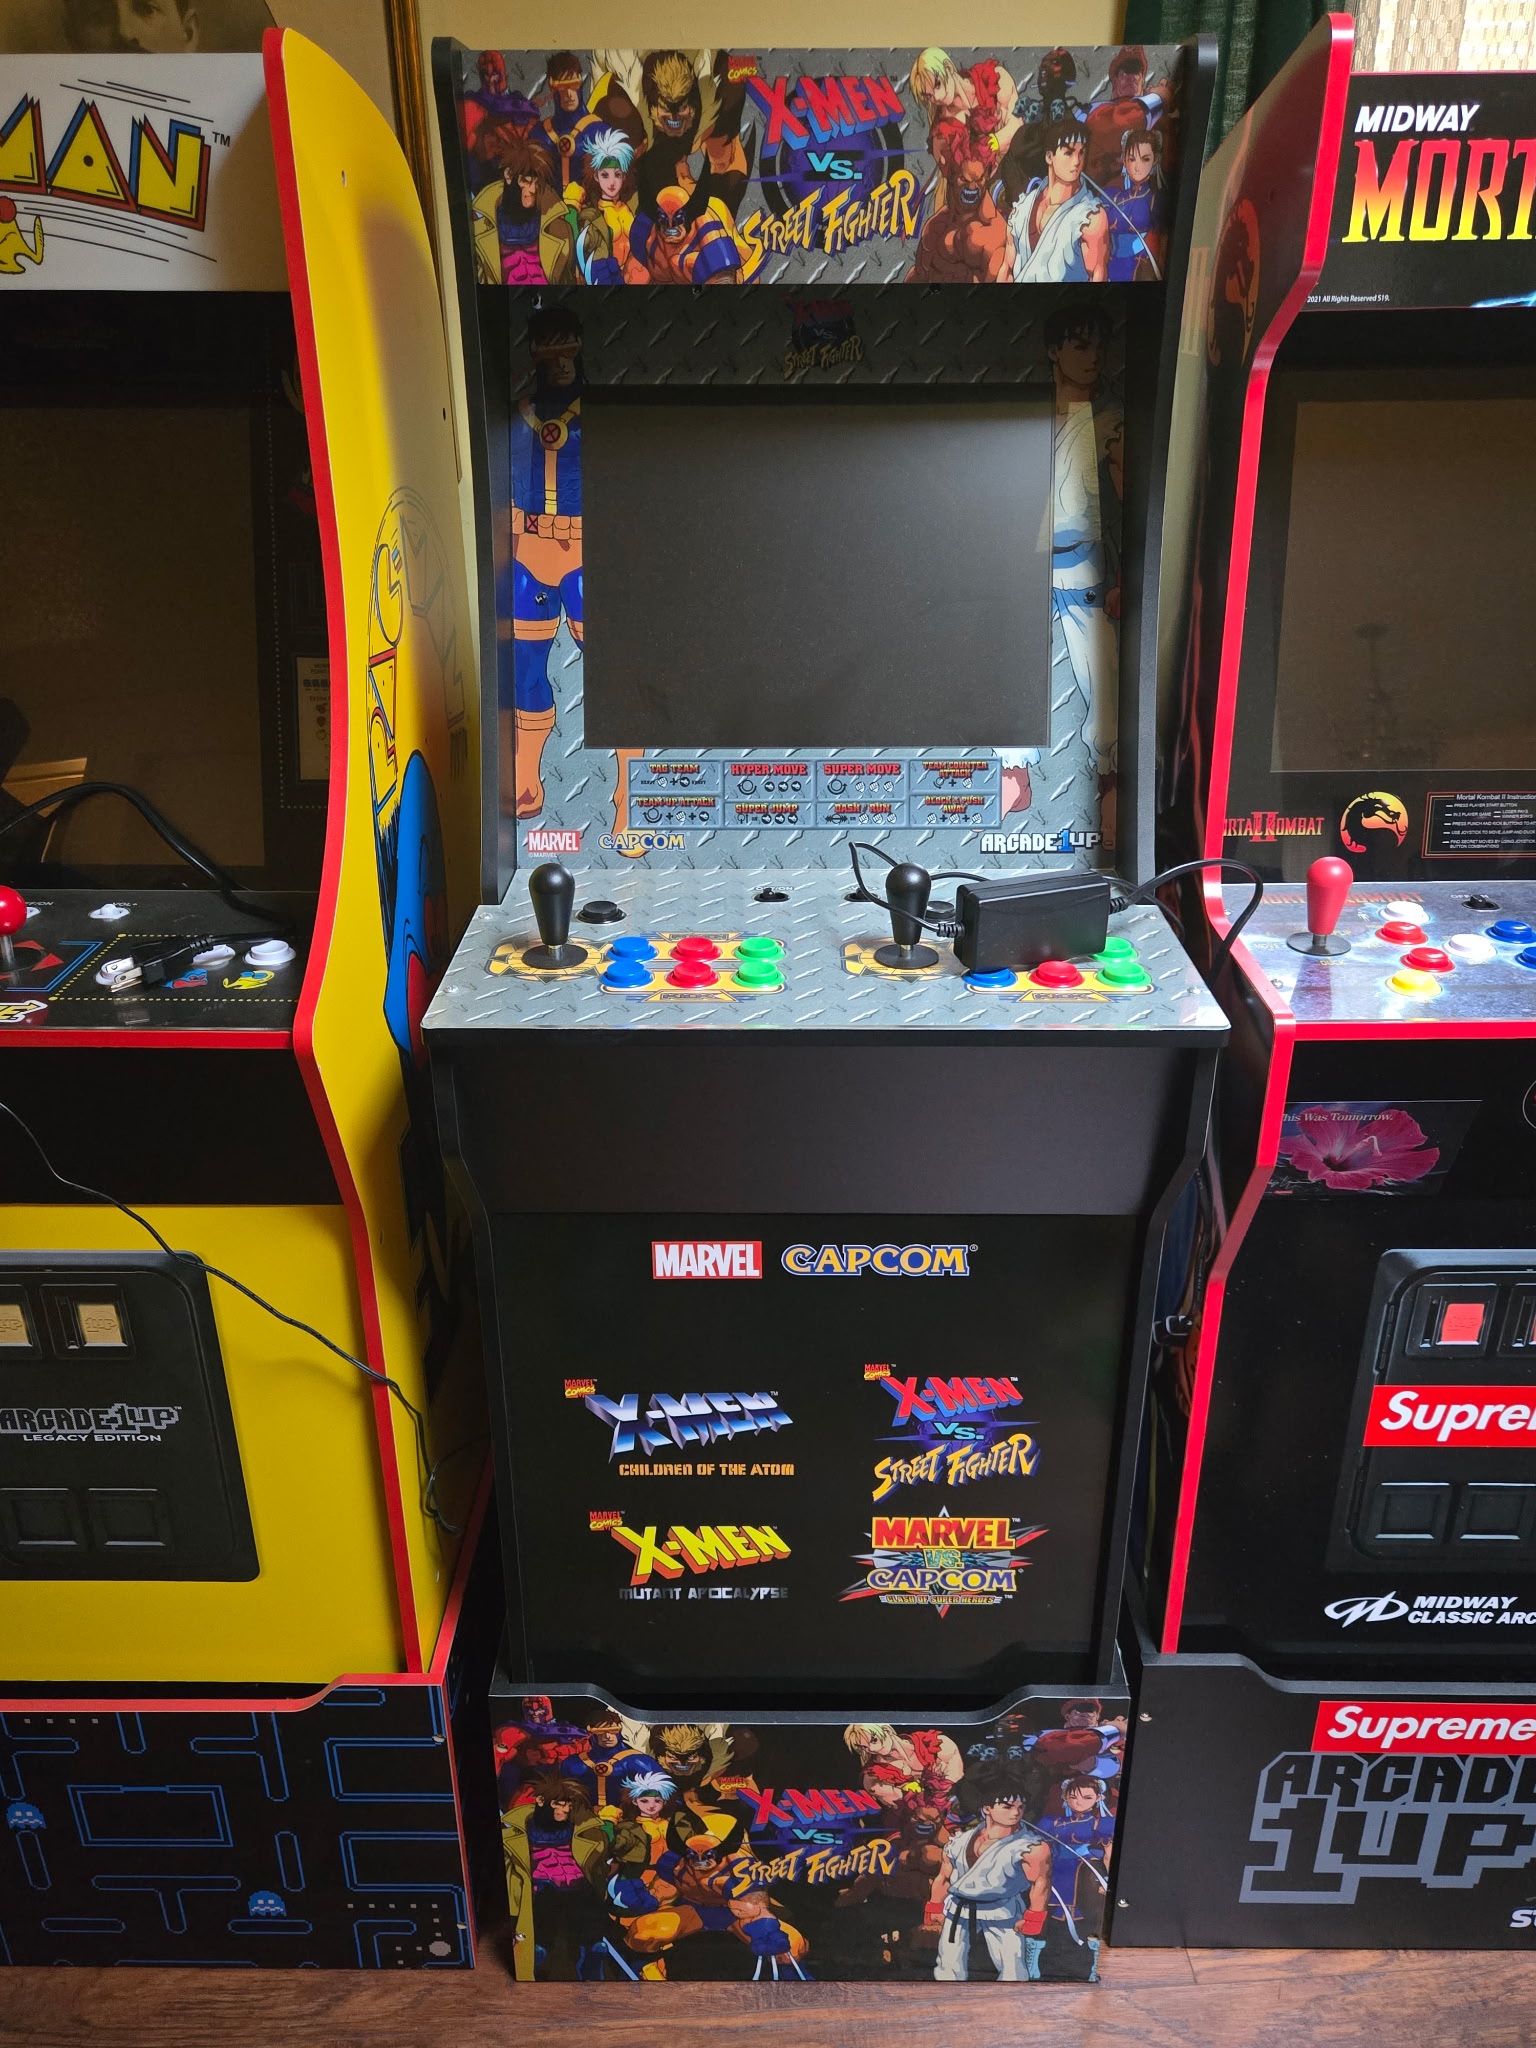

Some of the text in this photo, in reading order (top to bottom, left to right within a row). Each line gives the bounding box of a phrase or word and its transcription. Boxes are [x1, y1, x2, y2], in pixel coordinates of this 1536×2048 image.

[745, 75, 906, 159] X-MEN
[1354, 104, 1480, 132] MIDWAY
[807, 152, 863, 180] VS.
[741, 169, 922, 284] STREET FIGHTER
[1307, 295, 1320, 303] 2021
[1322, 295, 1330, 303] All
[1331, 294, 1349, 304] Rights
[1350, 294, 1377, 302] Reserved
[650, 763, 699, 773] TAG TEAM
[731, 764, 808, 776] HYPER MOVE
[823, 764, 900, 776] SUPER MOVE
[735, 803, 798, 814] SUPER JUMP
[834, 803, 860, 814] DASH
[869, 803, 891, 814] RUN
[528, 832, 685, 851] MARVEL CAPCOM
[1304, 1113, 1328, 1122] Was
[1330, 1112, 1393, 1122] Tomorrow.
[654, 1244, 760, 1277] MARVEL
[781, 1244, 970, 1277] CAPCOM
[864, 1363, 891, 1372] MARVEL
[864, 1370, 891, 1380] COMICS
[564, 1379, 594, 1388] MARVEL
[565, 1386, 596, 1398] COMICS
[880, 1376, 1024, 1427] X-MEN
[1379, 1390, 1536, 1442] Supre
[585, 1392, 794, 1464] X-MEN
[934, 1422, 984, 1440] VS.
[23, 1434, 162, 1442] LEGACY EDITION
[619, 1463, 795, 1476] CHILDREN OF THE ATOM
[872, 1433, 1040, 1503] STREET FIGHTER
[590, 1511, 622, 1520] MARVEL
[590, 1518, 623, 1530] COMICS
[872, 1517, 1016, 1549] MARVEL
[611, 1525, 792, 1586] X-MEN
[866, 1568, 1017, 1592] CAPCOM
[619, 1587, 789, 1601] MUTANT APOCALYPSE
[931, 1595, 960, 1604] SUPER
[1413, 1596, 1519, 1609] MIDWAY
[1407, 1611, 1495, 1624] CLASSIC
[1327, 1705, 1536, 1750] Supreme
[736, 1788, 882, 1832] X-MEN
[792, 1828, 843, 1845] VS.
[732, 1838, 897, 1898] STREET FIGHTER
